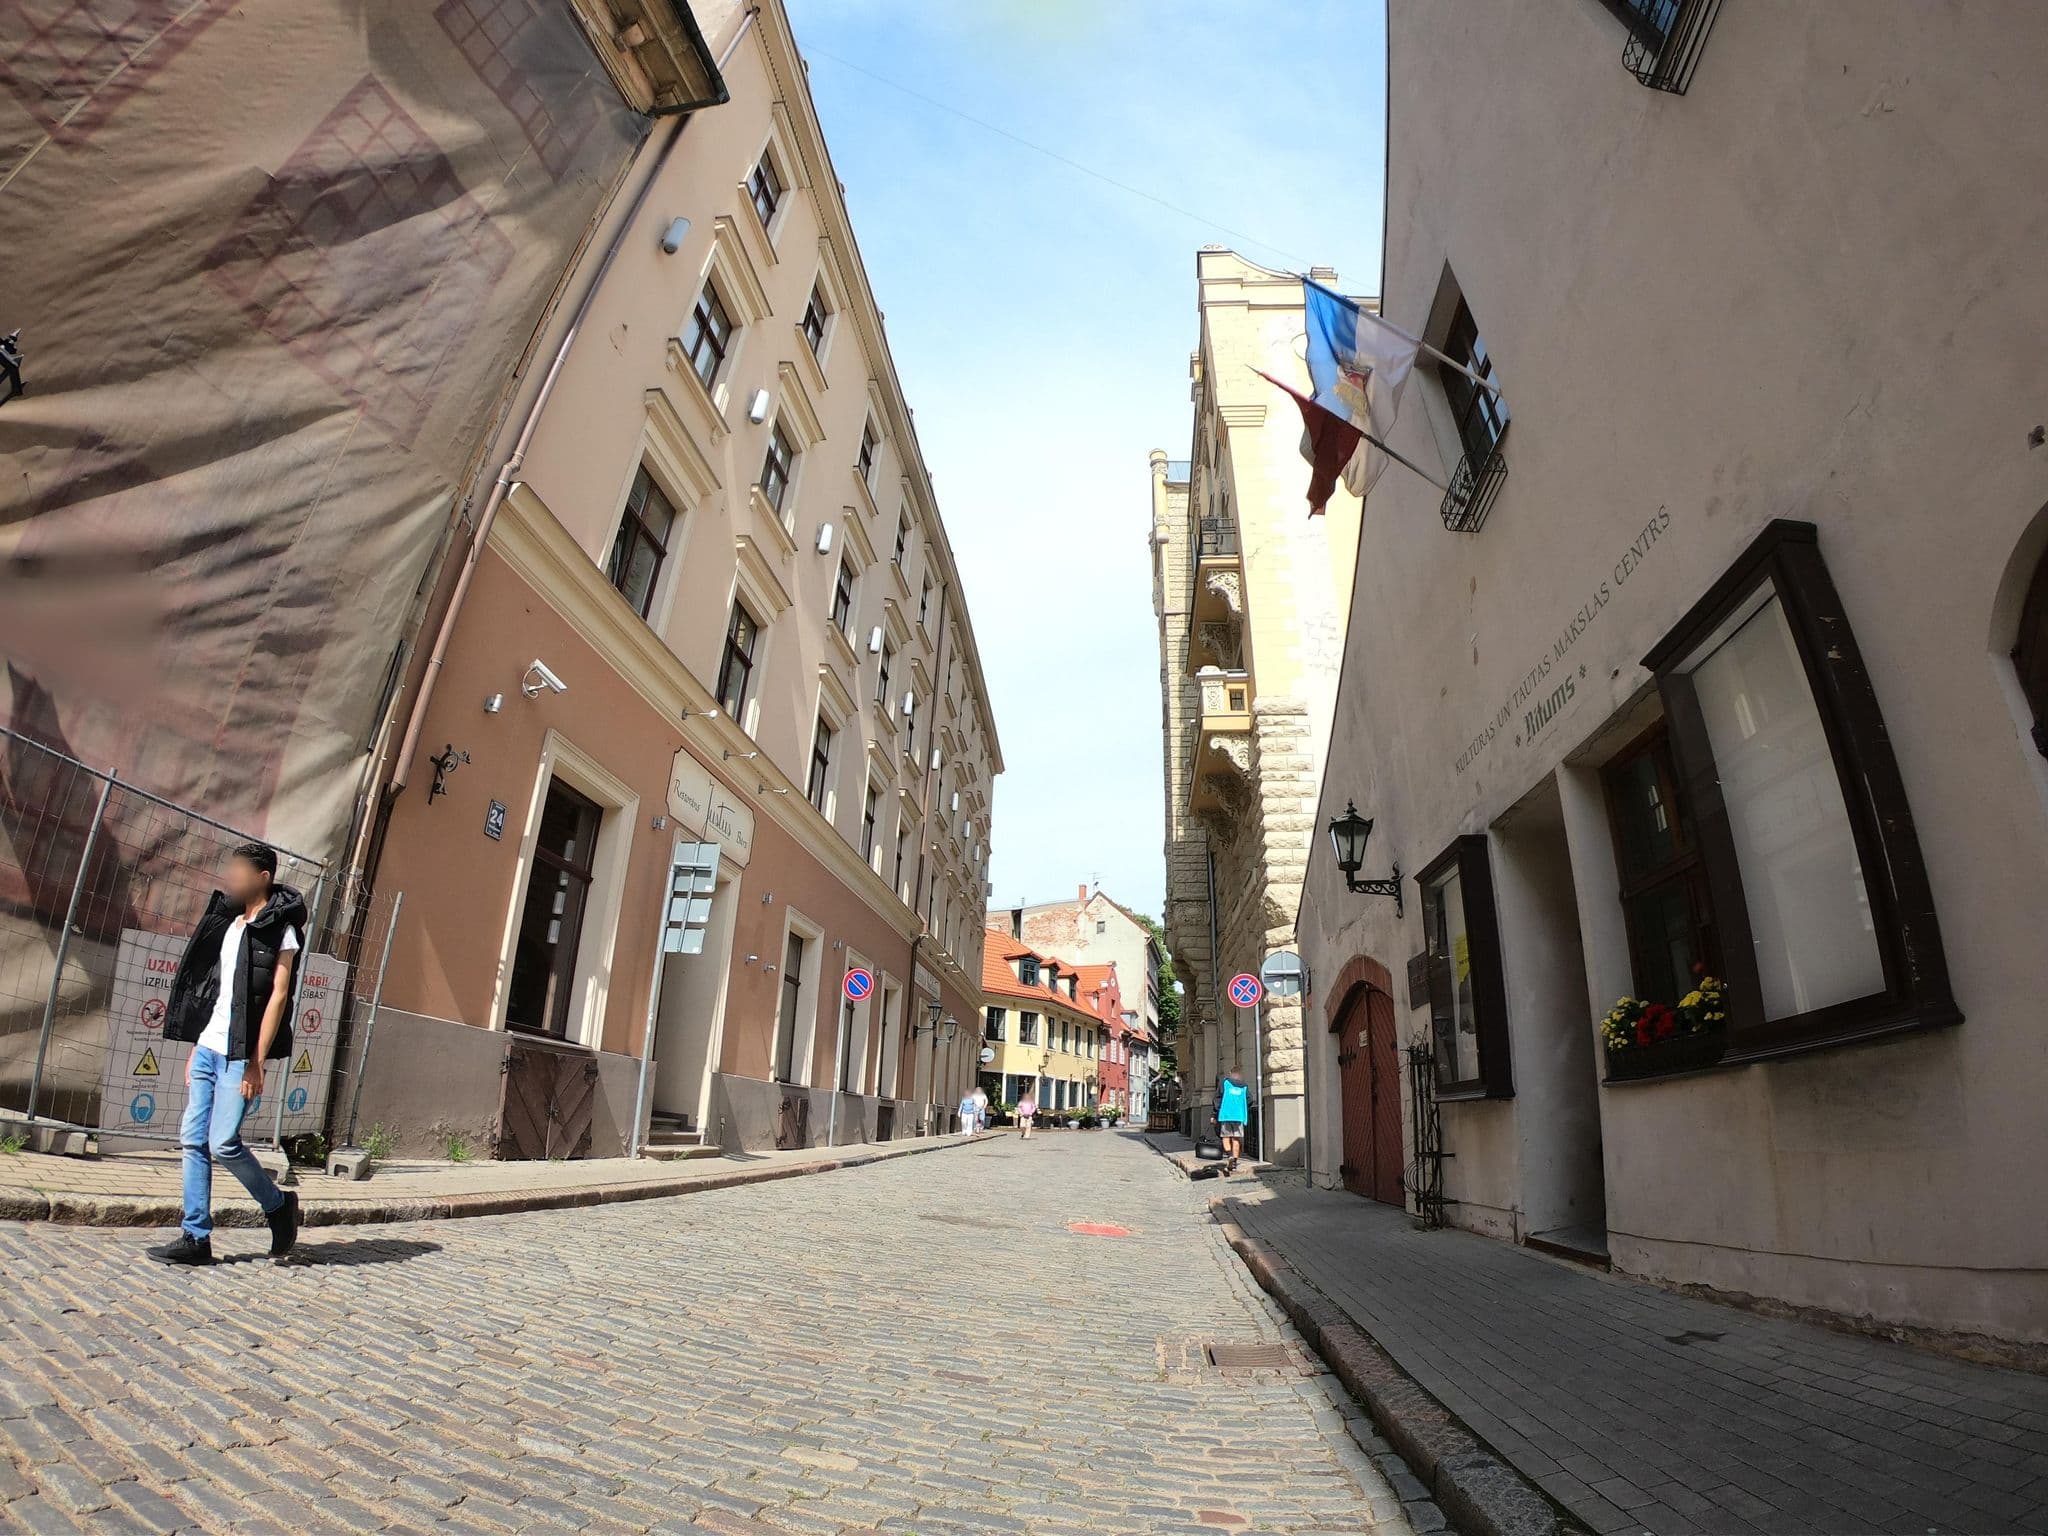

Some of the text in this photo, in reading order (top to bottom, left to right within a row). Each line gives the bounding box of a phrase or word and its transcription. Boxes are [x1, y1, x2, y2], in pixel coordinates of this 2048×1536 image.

[1496, 701, 1511, 728] UN
[1512, 654, 1551, 709] TAUTAS
[1614, 504, 1670, 586] CENTRS
[489, 809, 503, 826] 24
